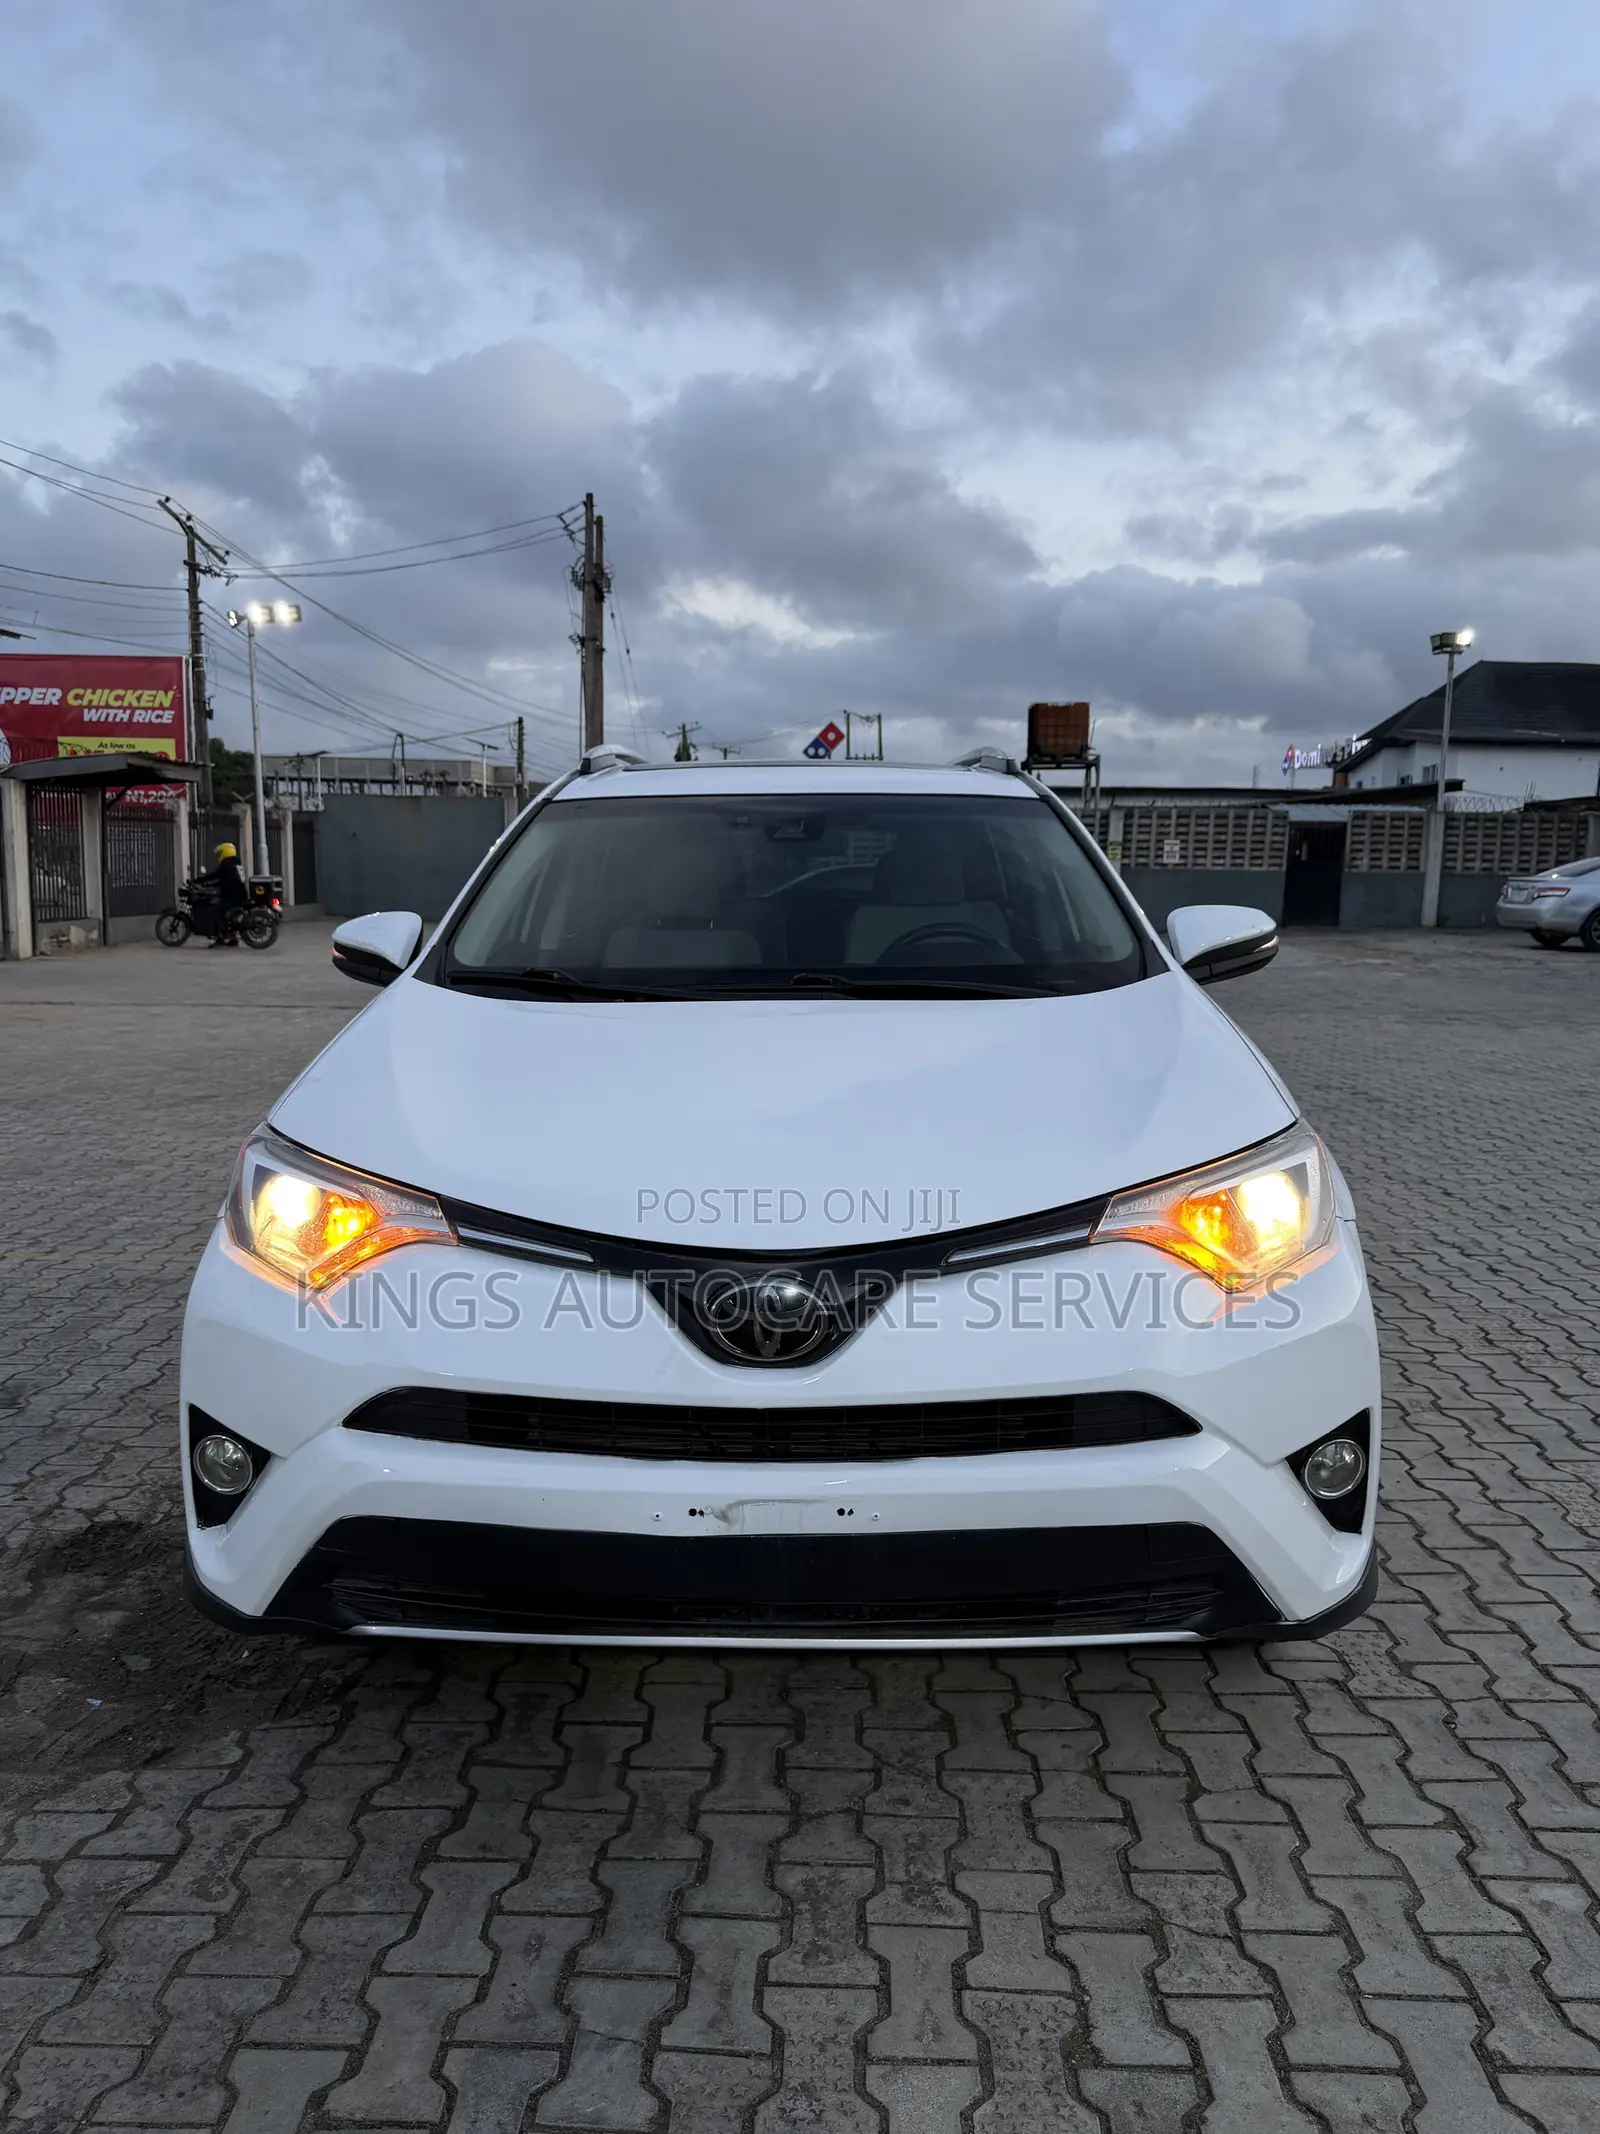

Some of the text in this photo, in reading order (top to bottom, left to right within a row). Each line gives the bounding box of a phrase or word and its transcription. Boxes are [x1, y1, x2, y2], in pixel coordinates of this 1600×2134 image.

[0, 686, 174, 708] PPER CHICKEN
[83, 708, 175, 724] WITH RICE
[98, 741, 108, 749] As
[110, 741, 124, 749] low
